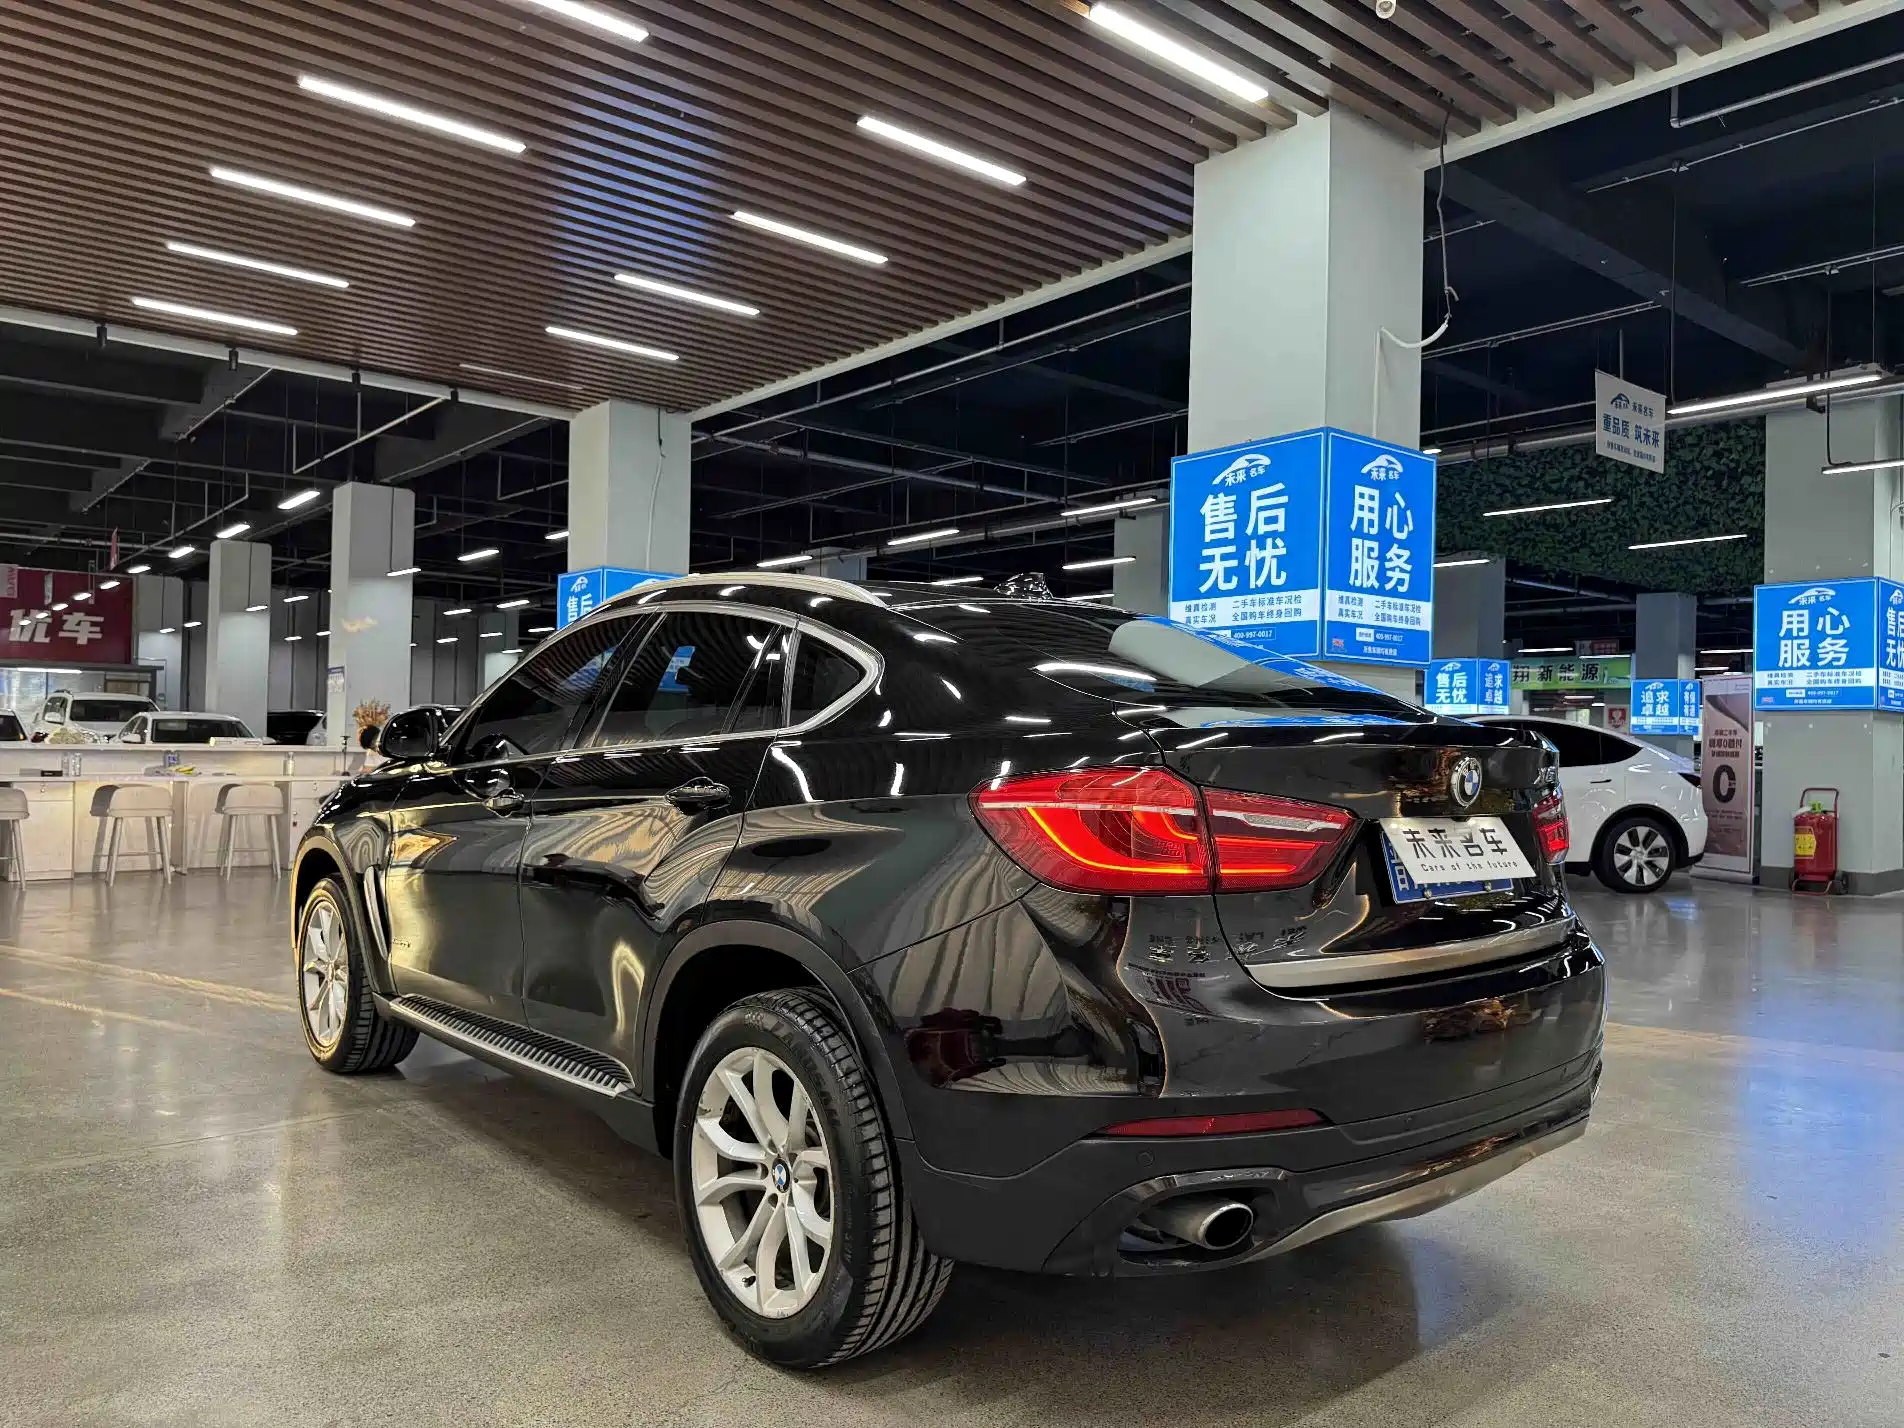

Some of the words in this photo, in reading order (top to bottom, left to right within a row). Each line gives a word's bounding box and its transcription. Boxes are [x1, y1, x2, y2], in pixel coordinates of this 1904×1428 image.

[1199, 483, 1289, 543] 售后
[1350, 484, 1414, 541] 用心
[1198, 538, 1287, 594] 无忧
[1348, 538, 1413, 594] 服务
[566, 592, 594, 623] 售后
[1232, 594, 1302, 609] 二手车标准车况检
[1185, 613, 1217, 625] 真实车况
[1232, 608, 1302, 622] 全国购车终身回购
[1778, 606, 1851, 638] 用心
[1778, 637, 1850, 668] 服务
[1435, 671, 1468, 688] 售后
[1511, 663, 1600, 683] 翔新能源
[1435, 688, 1468, 704] 无忧
[1640, 690, 1670, 704] 追求
[1402, 827, 1508, 859] 未来名车
[1420, 863, 1446, 872] Cars
[1450, 862, 1461, 871] of
[1466, 861, 1483, 870] the
[1486, 859, 1518, 869] future
